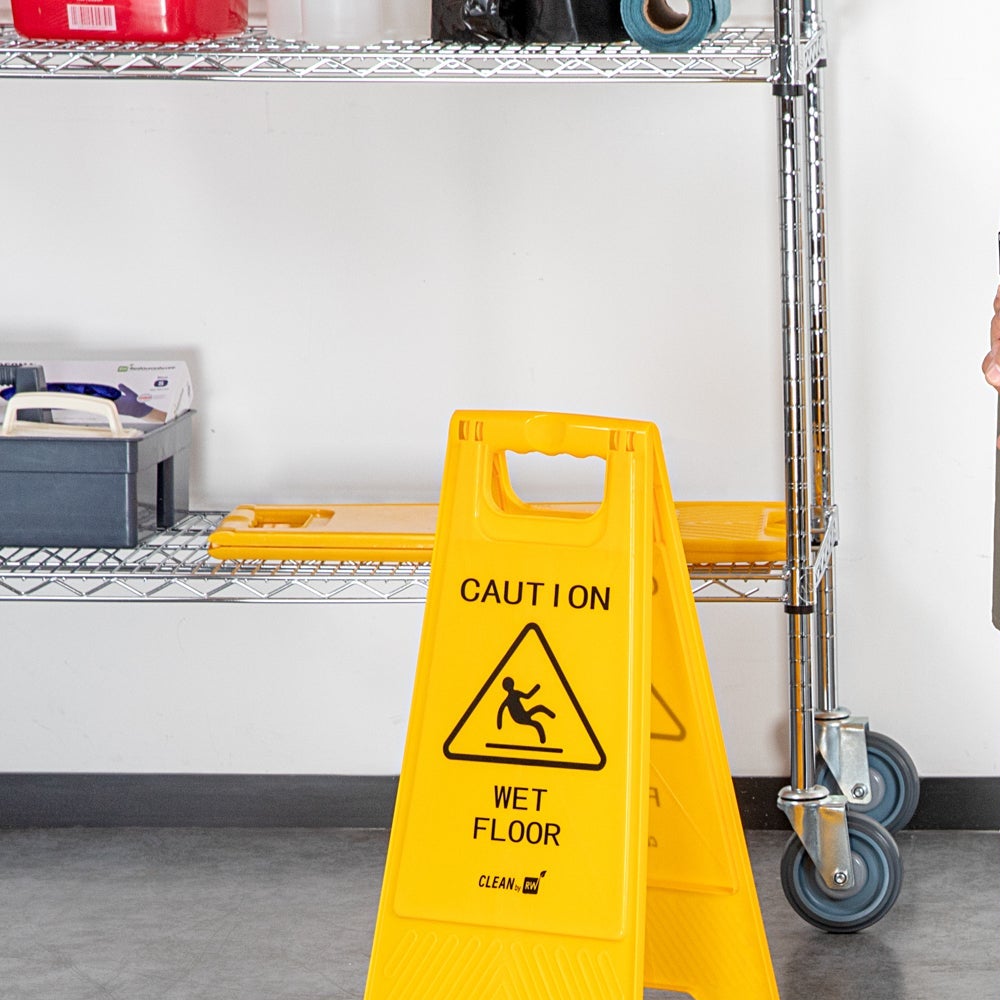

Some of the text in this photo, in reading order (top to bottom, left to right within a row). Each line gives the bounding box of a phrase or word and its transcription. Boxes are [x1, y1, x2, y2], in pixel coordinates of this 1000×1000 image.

[460, 577, 611, 611] CAUTION
[494, 785, 548, 812] WET
[473, 816, 561, 847] FLOOR
[478, 874, 515, 890] CLEAN
[524, 879, 539, 892] RW
